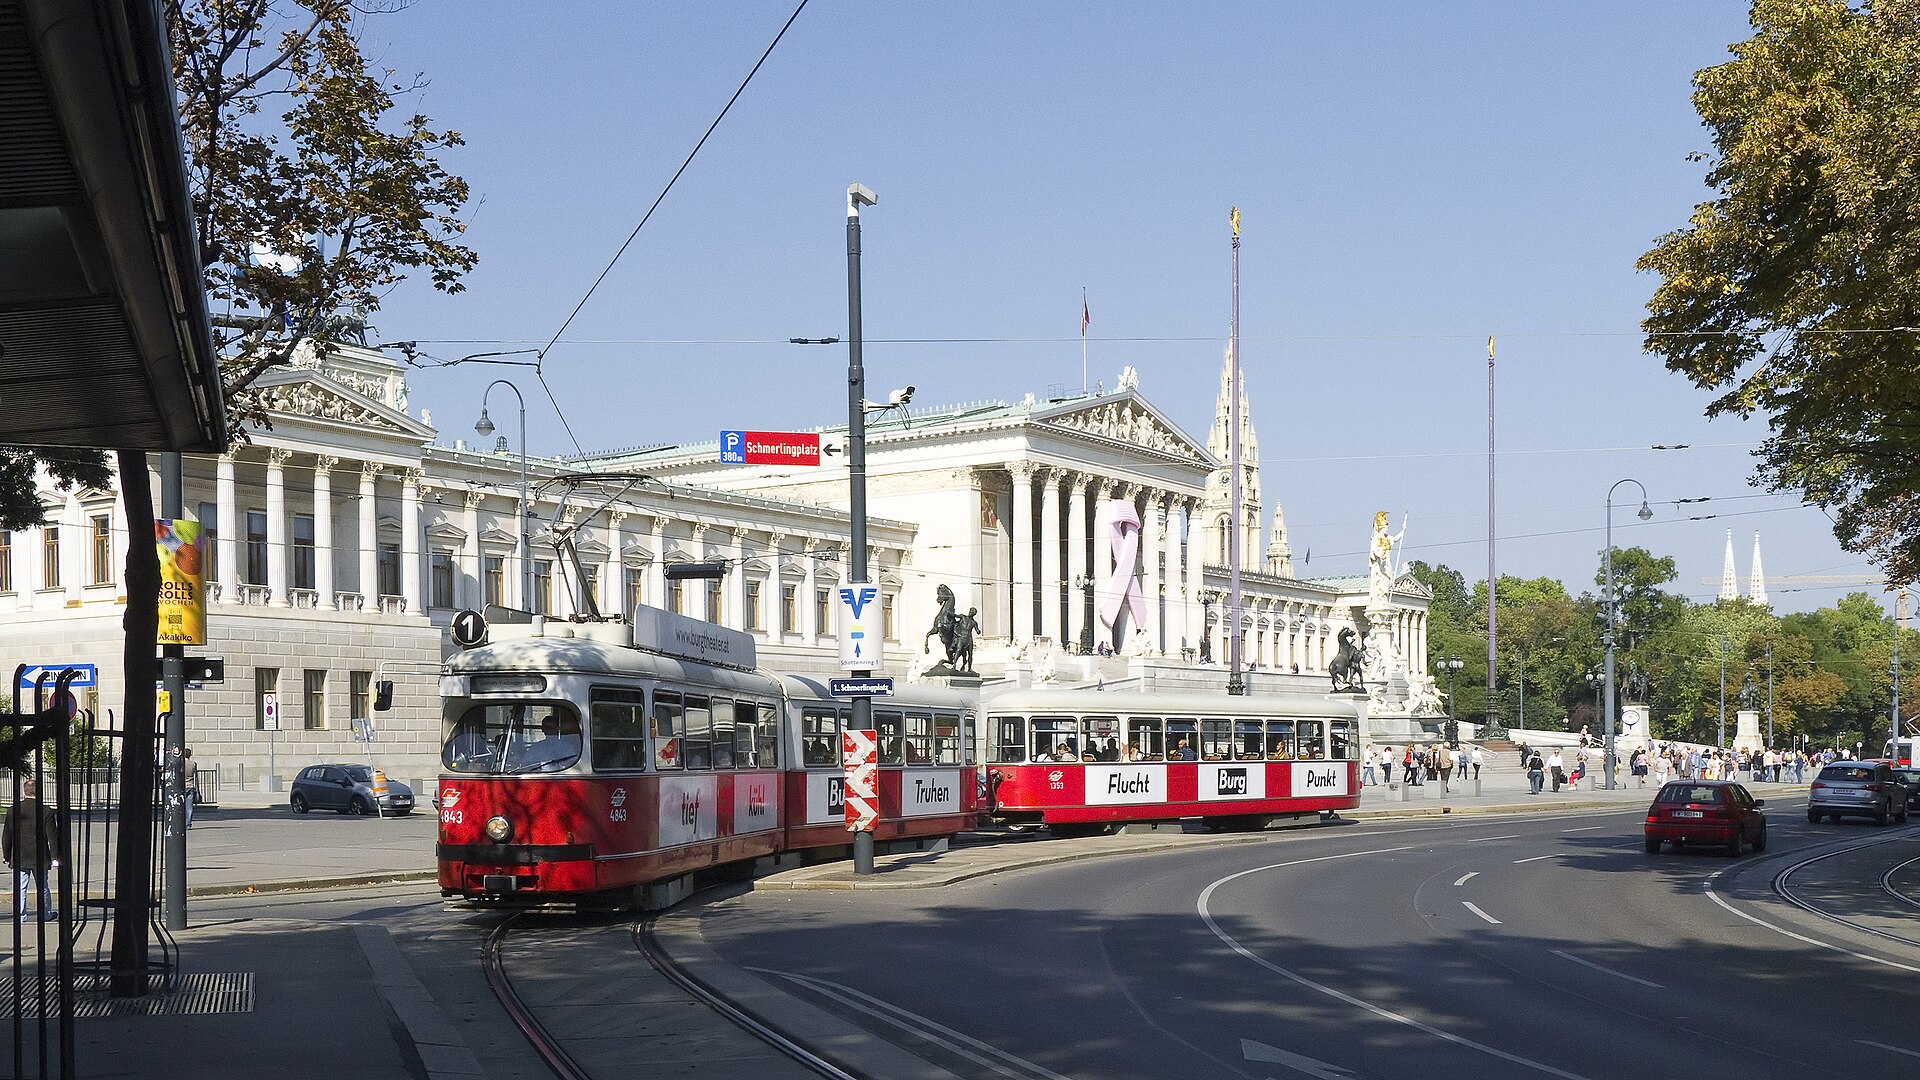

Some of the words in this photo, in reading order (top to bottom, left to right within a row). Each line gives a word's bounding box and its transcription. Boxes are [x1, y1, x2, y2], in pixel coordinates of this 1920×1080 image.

[746, 441, 818, 457] Schmerlingplatz
[158, 633, 193, 641] Akakiko
[461, 614, 474, 640] 1
[674, 624, 730, 654] www.burgtheater.at
[840, 683, 890, 694] Schmerlingplatz
[1049, 781, 1064, 790] 1353
[1107, 771, 1150, 796] Flucht
[1218, 768, 1248, 795] Burg
[1306, 768, 1336, 788] Punkt
[748, 784, 766, 817] kühl
[915, 778, 949, 804] Truhen
[609, 808, 627, 822] 4843
[681, 787, 700, 834] tief
